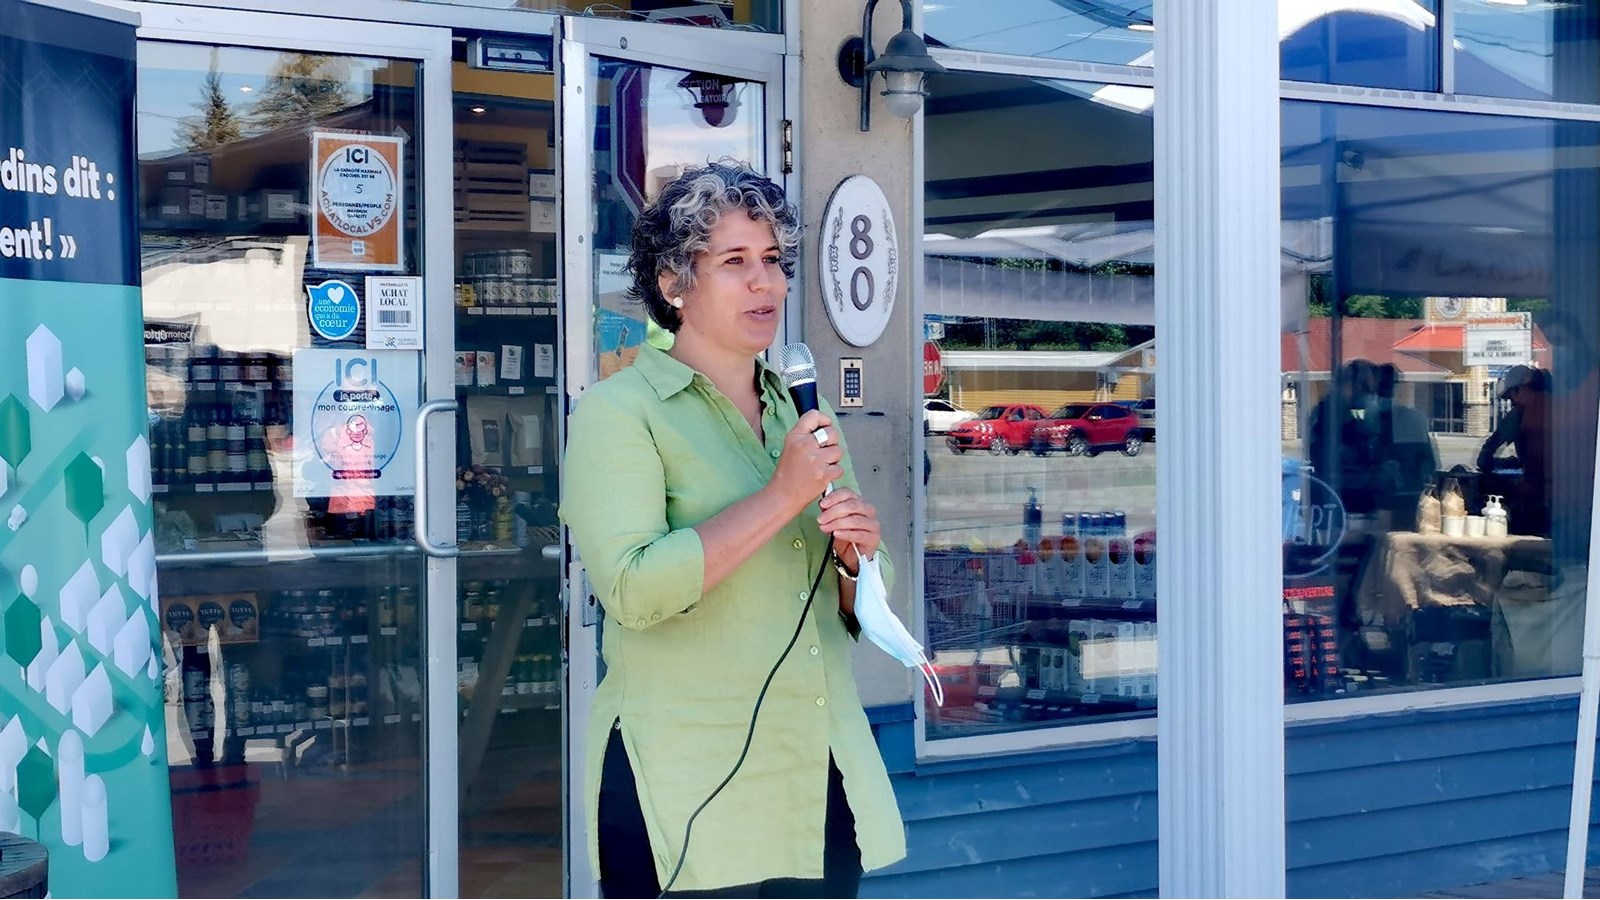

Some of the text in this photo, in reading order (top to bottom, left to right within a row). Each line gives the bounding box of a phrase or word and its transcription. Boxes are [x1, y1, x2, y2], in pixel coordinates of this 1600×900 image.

[346, 148, 369, 164] ICI
[0, 147, 58, 195] dins
[63, 155, 101, 200] dit
[355, 184, 364, 194] 5
[0, 218, 53, 260] ent!
[380, 289, 408, 298] ACHAT
[380, 298, 408, 307] LOCAL
[314, 304, 355, 313] économie
[320, 319, 348, 328] cœur
[335, 357, 378, 387] ICI
[350, 392, 373, 401] porte
[337, 404, 395, 413] couvre-visage
